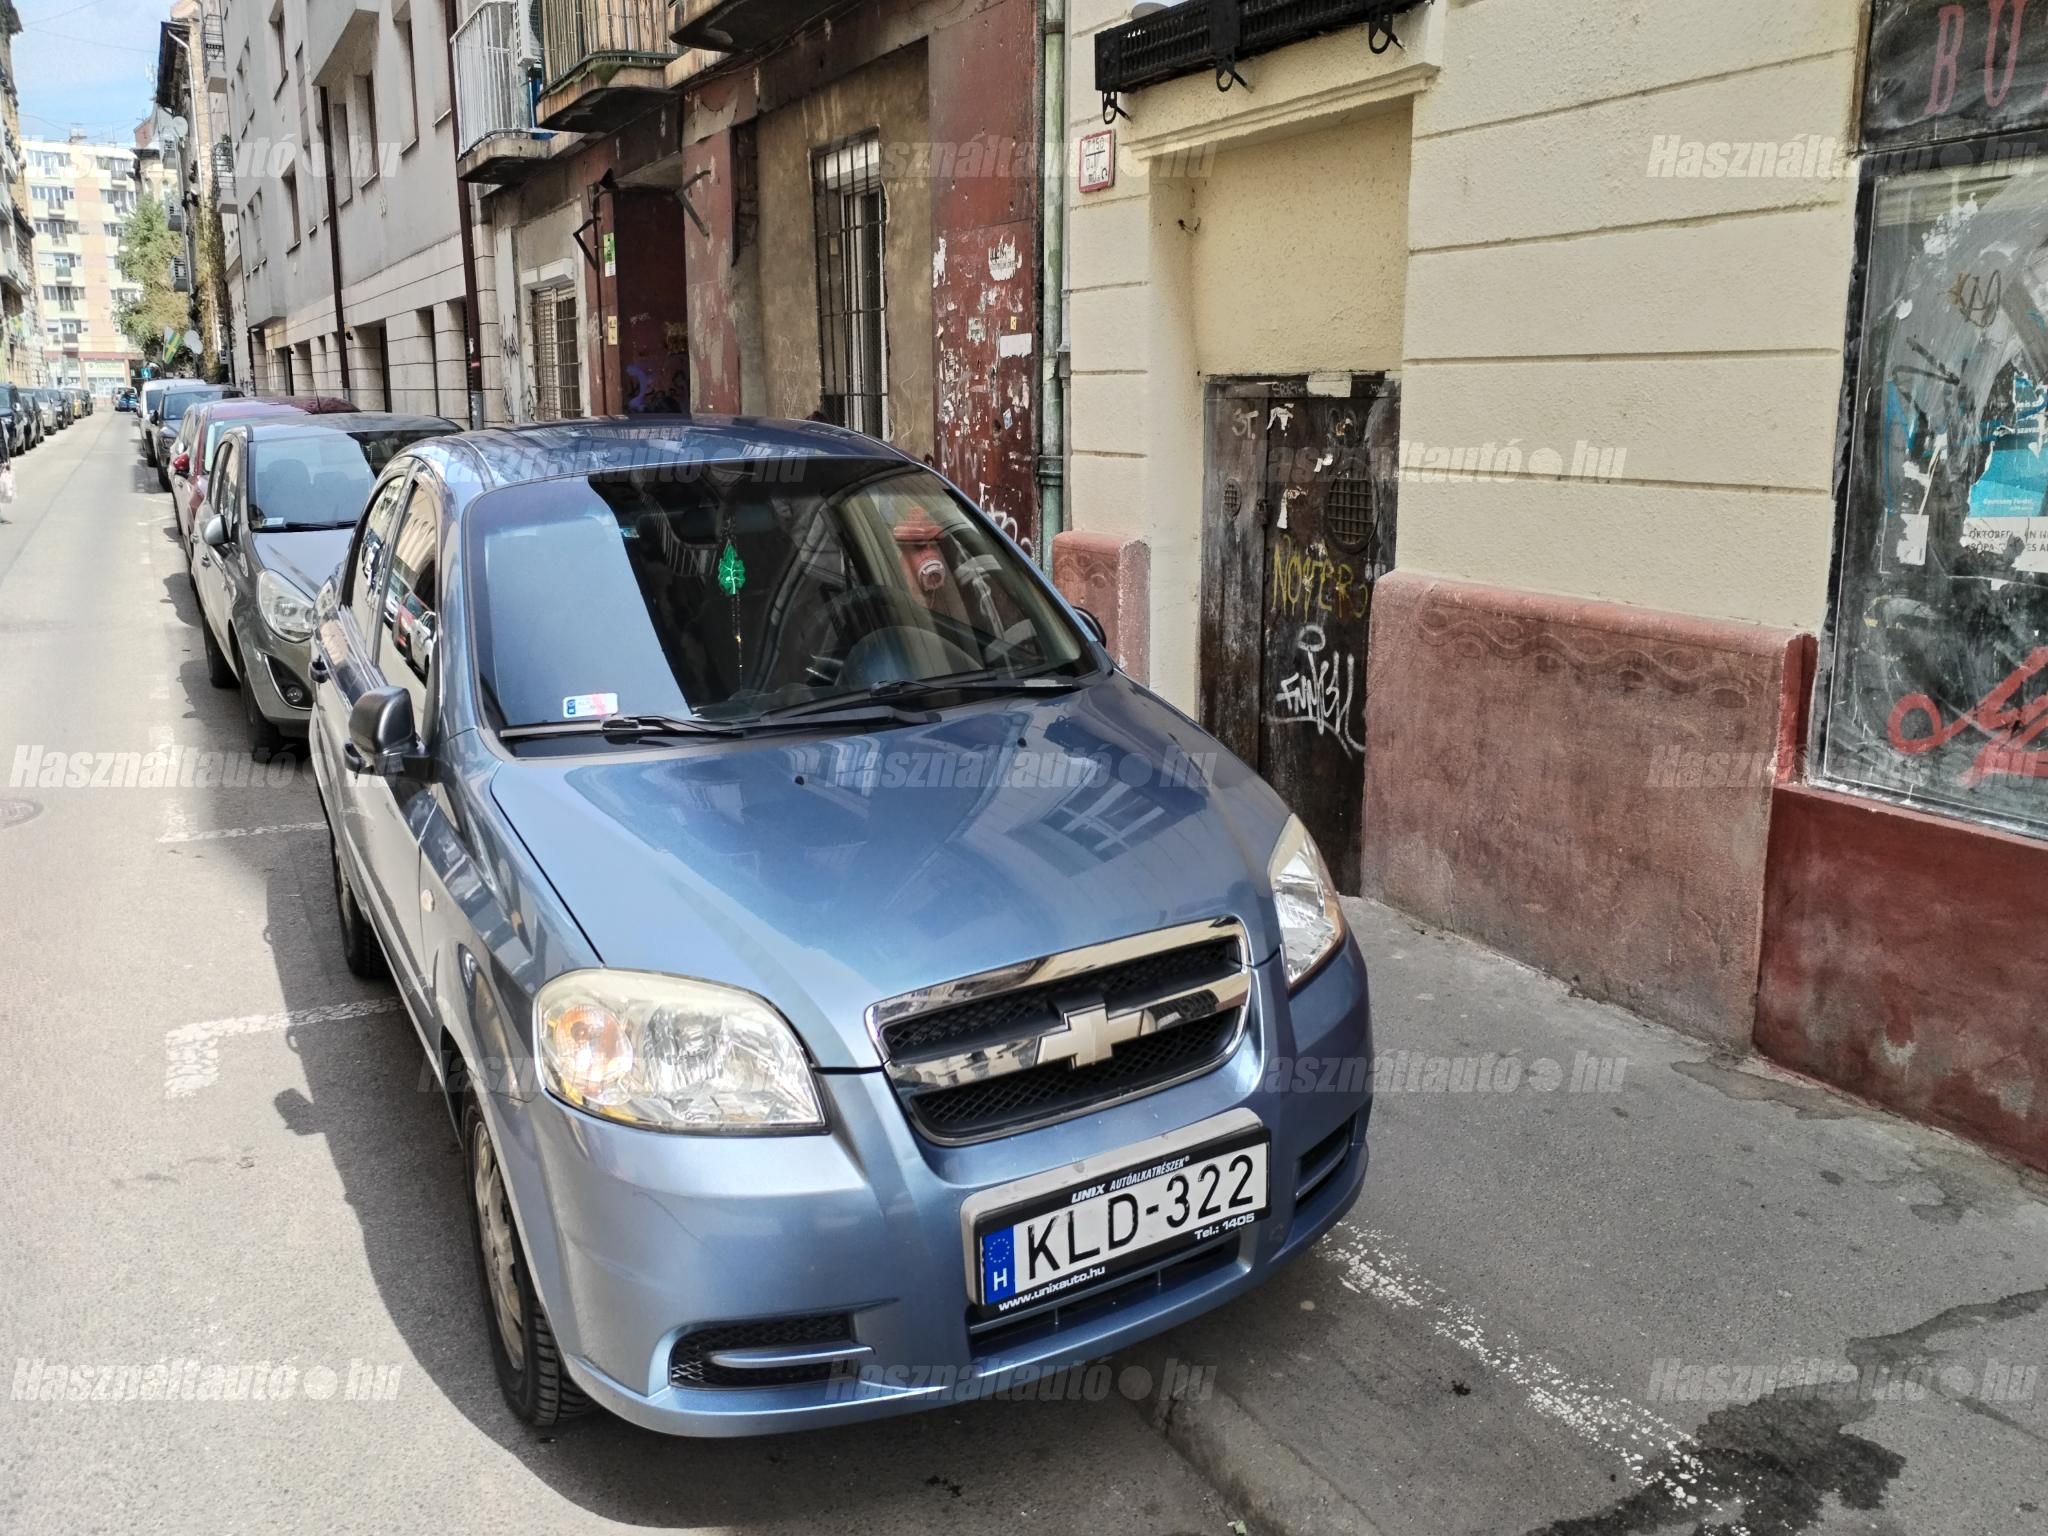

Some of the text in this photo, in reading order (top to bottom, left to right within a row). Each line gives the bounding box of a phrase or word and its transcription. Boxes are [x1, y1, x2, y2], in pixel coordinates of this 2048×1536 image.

[1924, 0, 2048, 115] BU
[1071, 1183, 1104, 1204] UNIX
[1027, 1154, 1254, 1281] KLD-322
[1222, 1212, 1255, 1230] 1405
[993, 1267, 1008, 1291] H
[998, 1266, 1106, 1312] www.unixauto.hu
